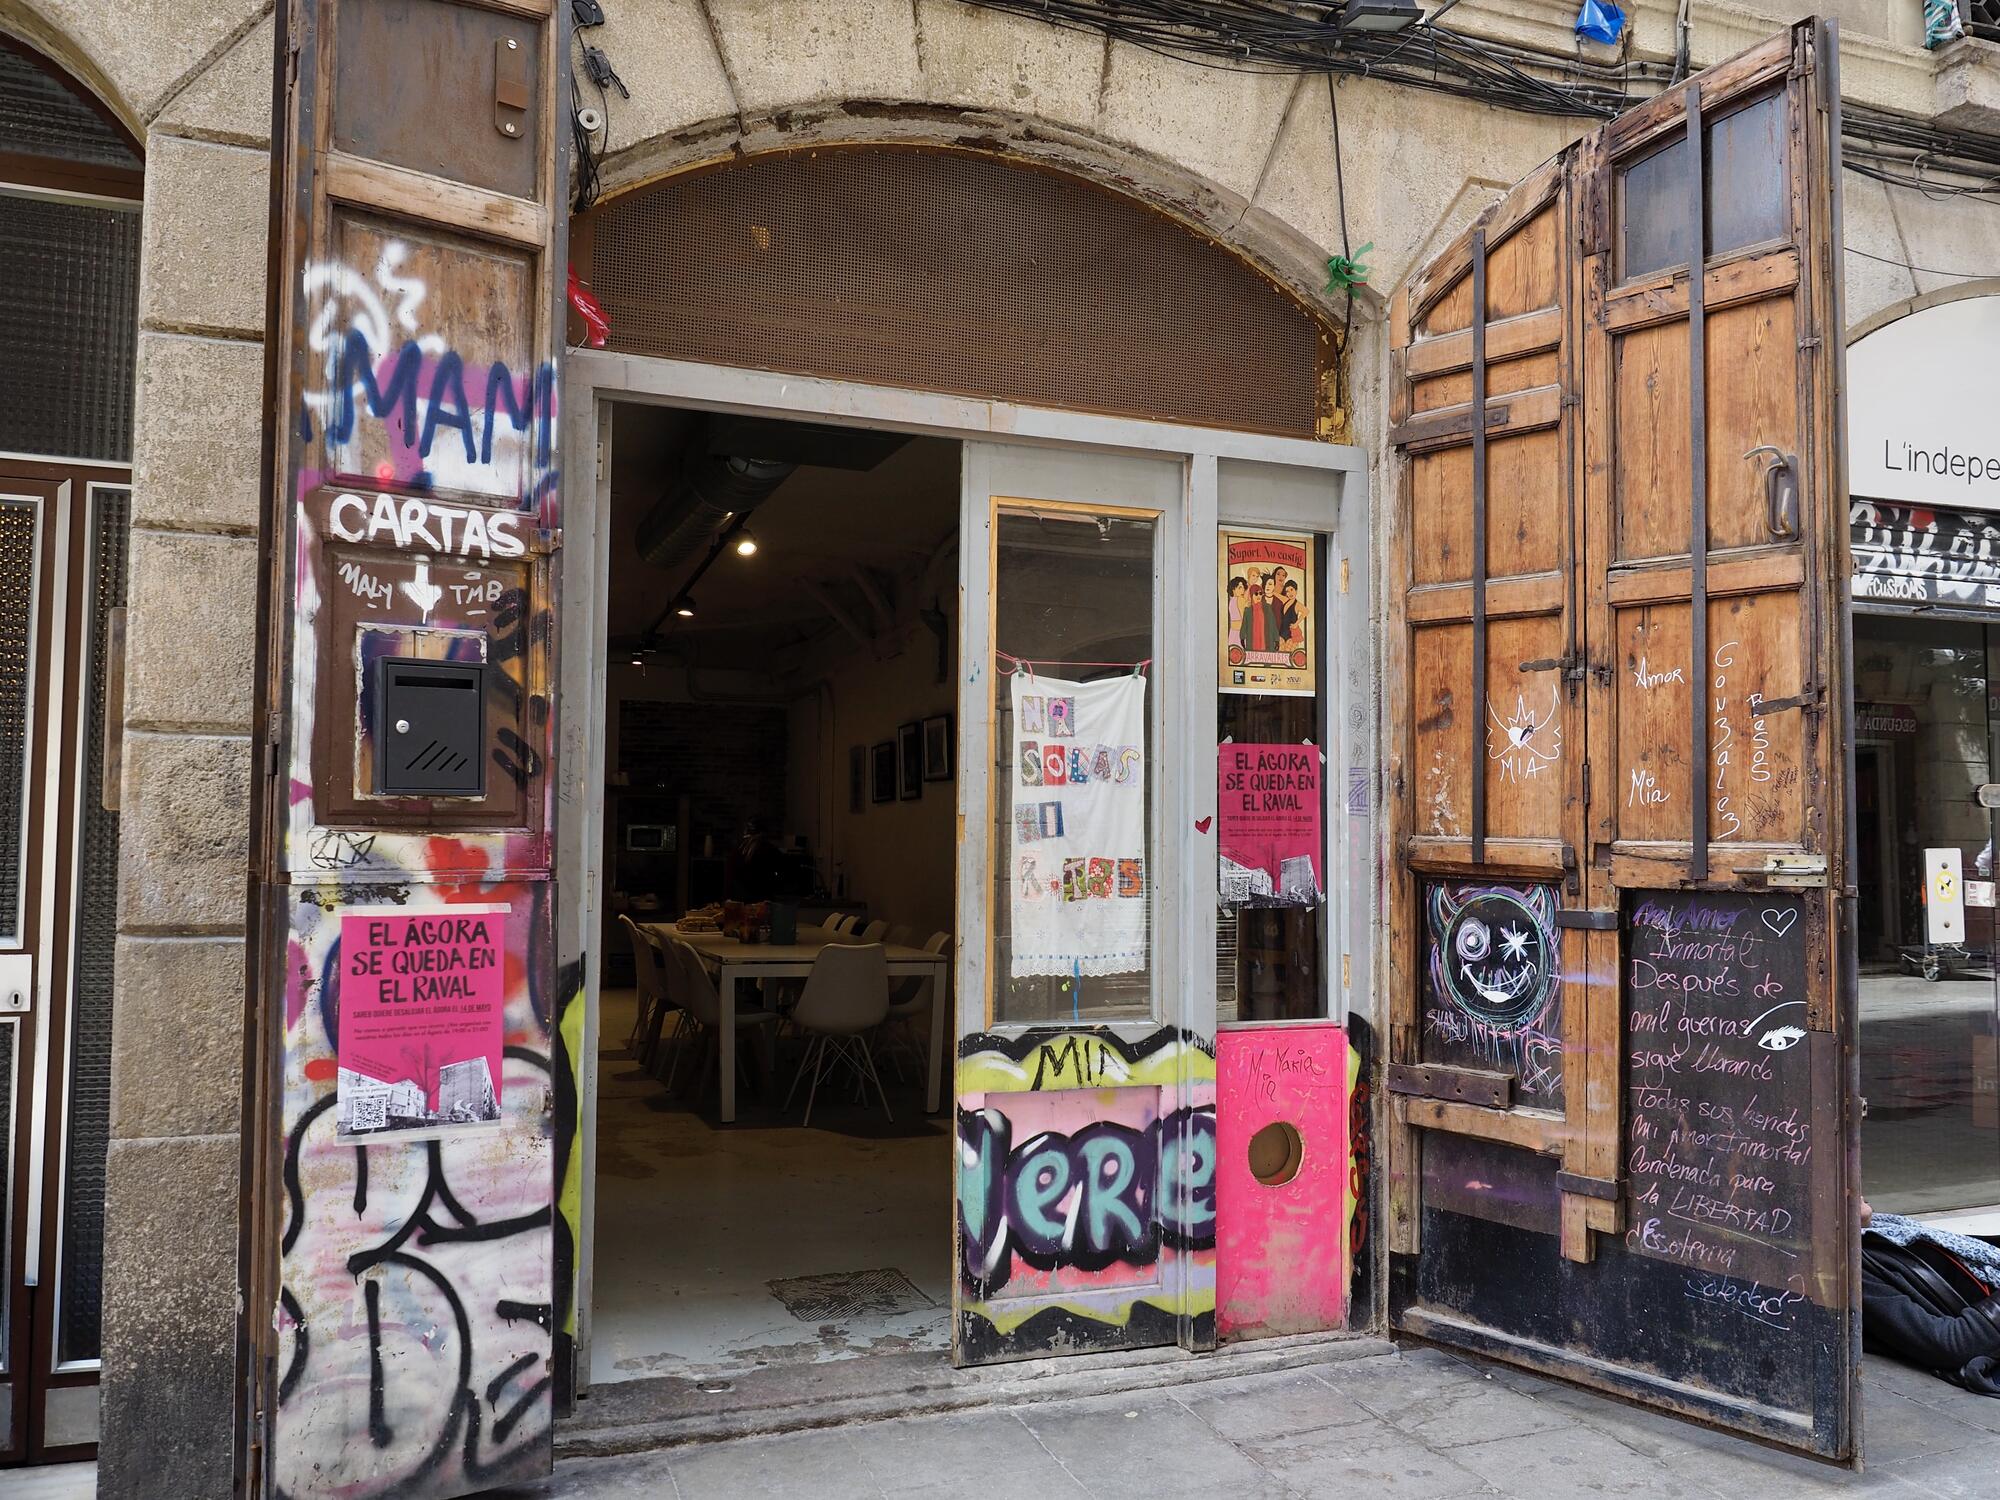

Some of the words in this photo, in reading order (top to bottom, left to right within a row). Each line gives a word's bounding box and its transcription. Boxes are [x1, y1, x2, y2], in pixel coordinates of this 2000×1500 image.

[330, 493, 525, 557] CARTAS
[1021, 746, 1141, 785] SOLAS
[1235, 753, 1254, 770] EL
[1257, 751, 1311, 773] ÁGORA
[1500, 756, 1548, 784] MIA
[1226, 773, 1245, 791] SE
[1250, 774, 1296, 791] QUEDA
[1298, 774, 1315, 790] EN
[1629, 768, 1670, 808] Mia
[1243, 794, 1260, 812] EL
[1263, 793, 1303, 812] RAVAL
[370, 922, 397, 946] EL
[404, 918, 490, 947] ÁGORA
[352, 951, 383, 976] SE
[392, 948, 465, 975] QUEDA
[469, 948, 495, 969] EN
[379, 980, 407, 1003] EL
[413, 975, 475, 1002] RAVAL
[1754, 973, 1783, 999] de
[1630, 1001, 1671, 1033] mil
[1030, 1035, 1133, 1091] MIA
[1637, 1182, 1659, 1207] la
[1729, 1174, 1776, 1204] para
